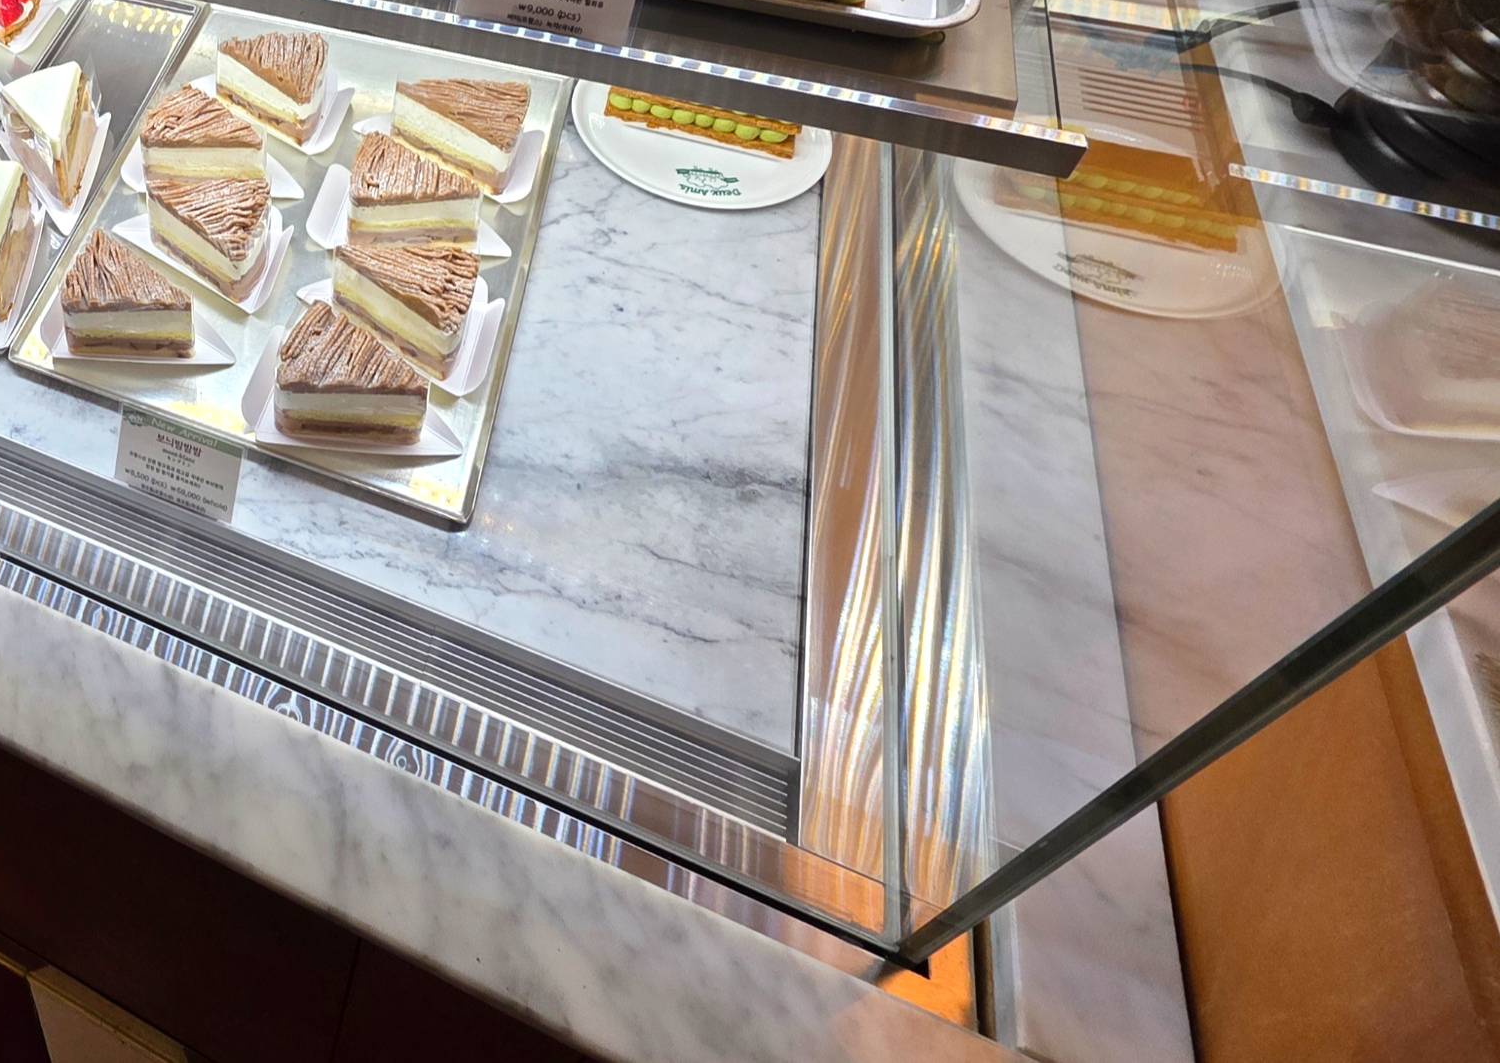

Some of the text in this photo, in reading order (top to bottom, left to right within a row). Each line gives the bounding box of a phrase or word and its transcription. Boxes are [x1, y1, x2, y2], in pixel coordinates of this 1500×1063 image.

[557, 8, 582, 23] (pcs)
[679, 183, 742, 196] Deux Amis
[151, 418, 218, 447] New Arrival
[156, 433, 202, 457] 보늬밤밤밤
[151, 477, 168, 489] (pcs)
[202, 496, 228, 512] (whole)
